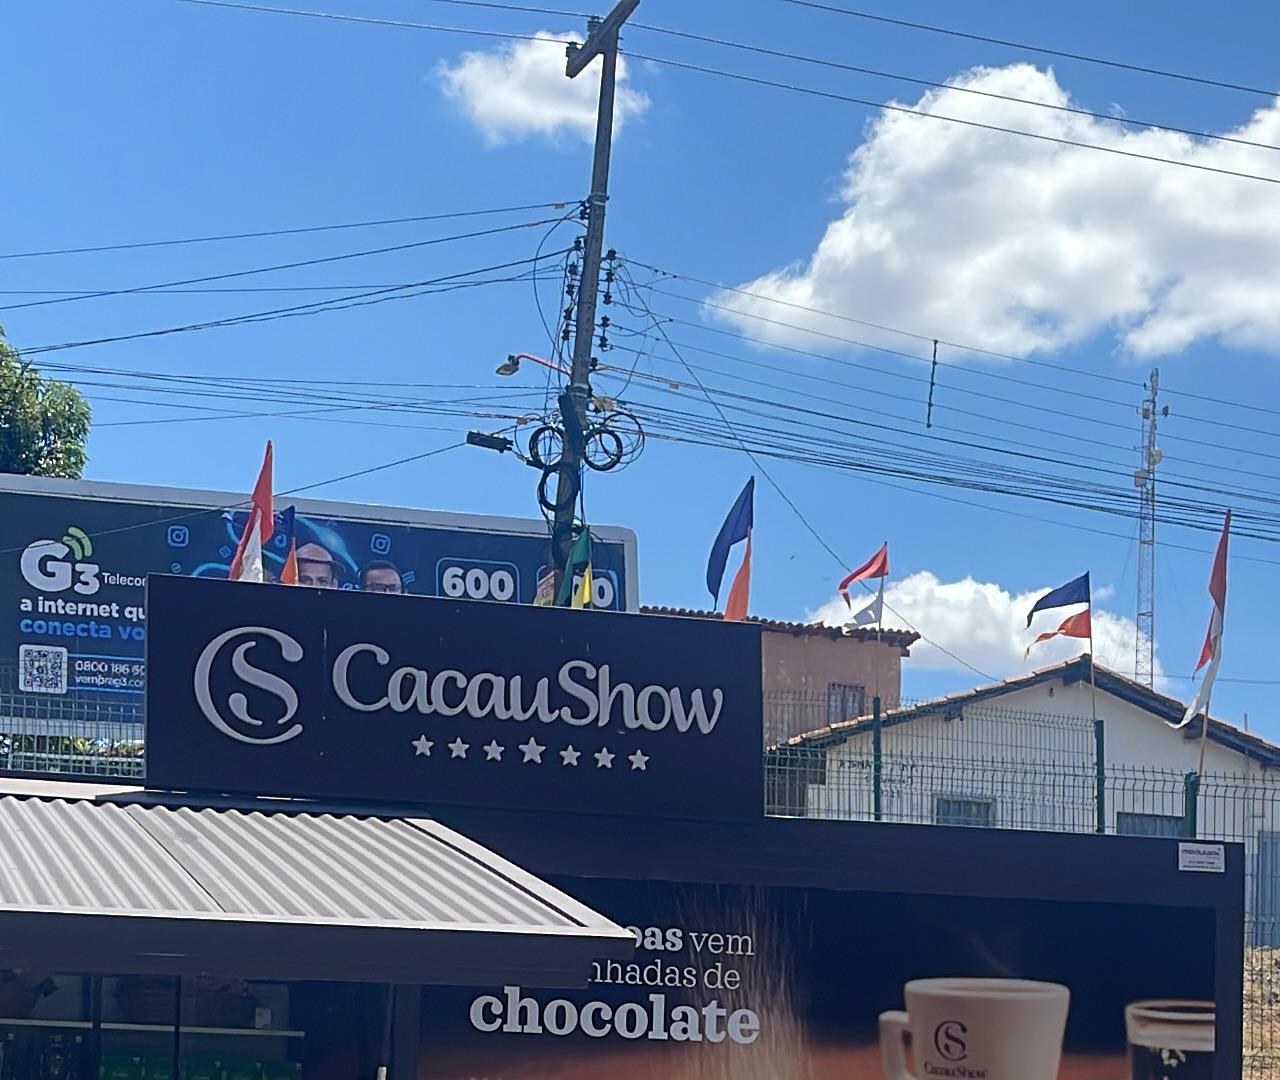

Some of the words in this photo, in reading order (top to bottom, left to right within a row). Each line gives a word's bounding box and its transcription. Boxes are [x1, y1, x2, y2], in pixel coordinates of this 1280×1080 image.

[20, 539, 100, 595] G3
[442, 566, 514, 601] 600
[20, 599, 32, 612] a
[38, 597, 119, 618] internet
[20, 618, 112, 640] conecta
[75, 660, 108, 672] 0800
[689, 932, 754, 956] vem
[704, 962, 741, 990] de
[470, 986, 760, 1044] chocolate
